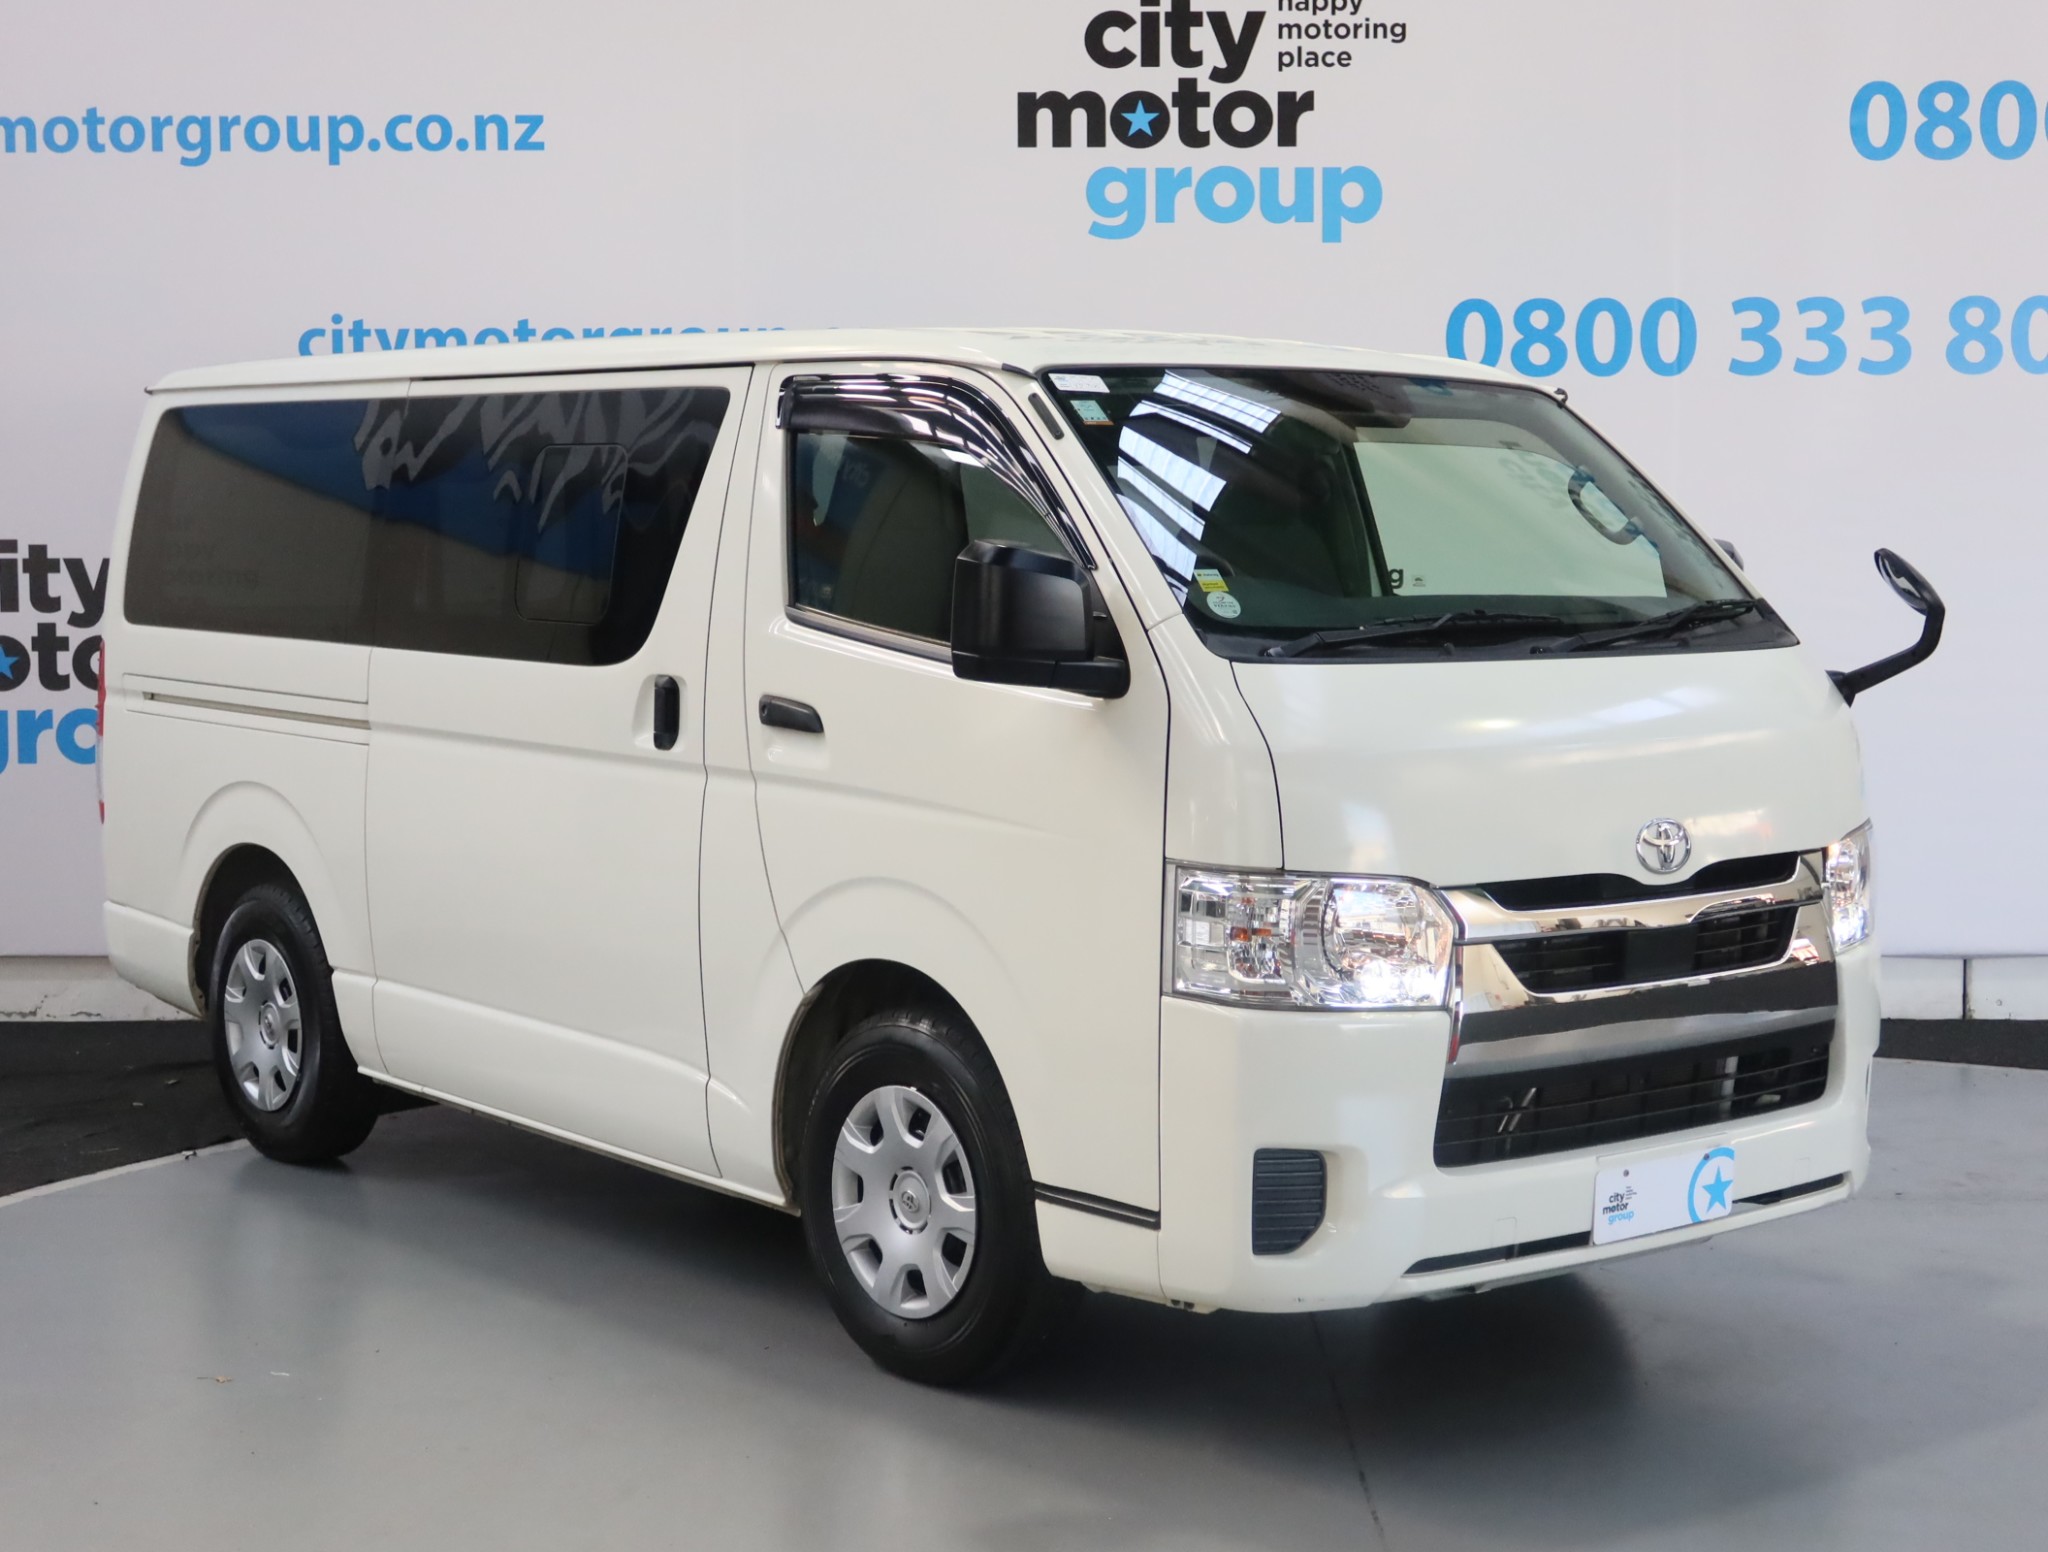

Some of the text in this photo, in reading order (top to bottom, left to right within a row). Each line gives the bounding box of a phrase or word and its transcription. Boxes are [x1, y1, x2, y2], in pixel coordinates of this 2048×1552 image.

[1084, 0, 1267, 84] city
[1278, 18, 1407, 44] motoring
[1278, 46, 1353, 72] place
[1017, 77, 1315, 149] motor
[1849, 80, 2048, 161] 080
[1086, 165, 1383, 243] group
[1445, 297, 1698, 378] 0800
[1727, 296, 1912, 376] 333
[0, 708, 97, 774] ro
[1602, 1202, 1629, 1215] motor
[1607, 1210, 1635, 1225] group
[1608, 1192, 1625, 1204] city
